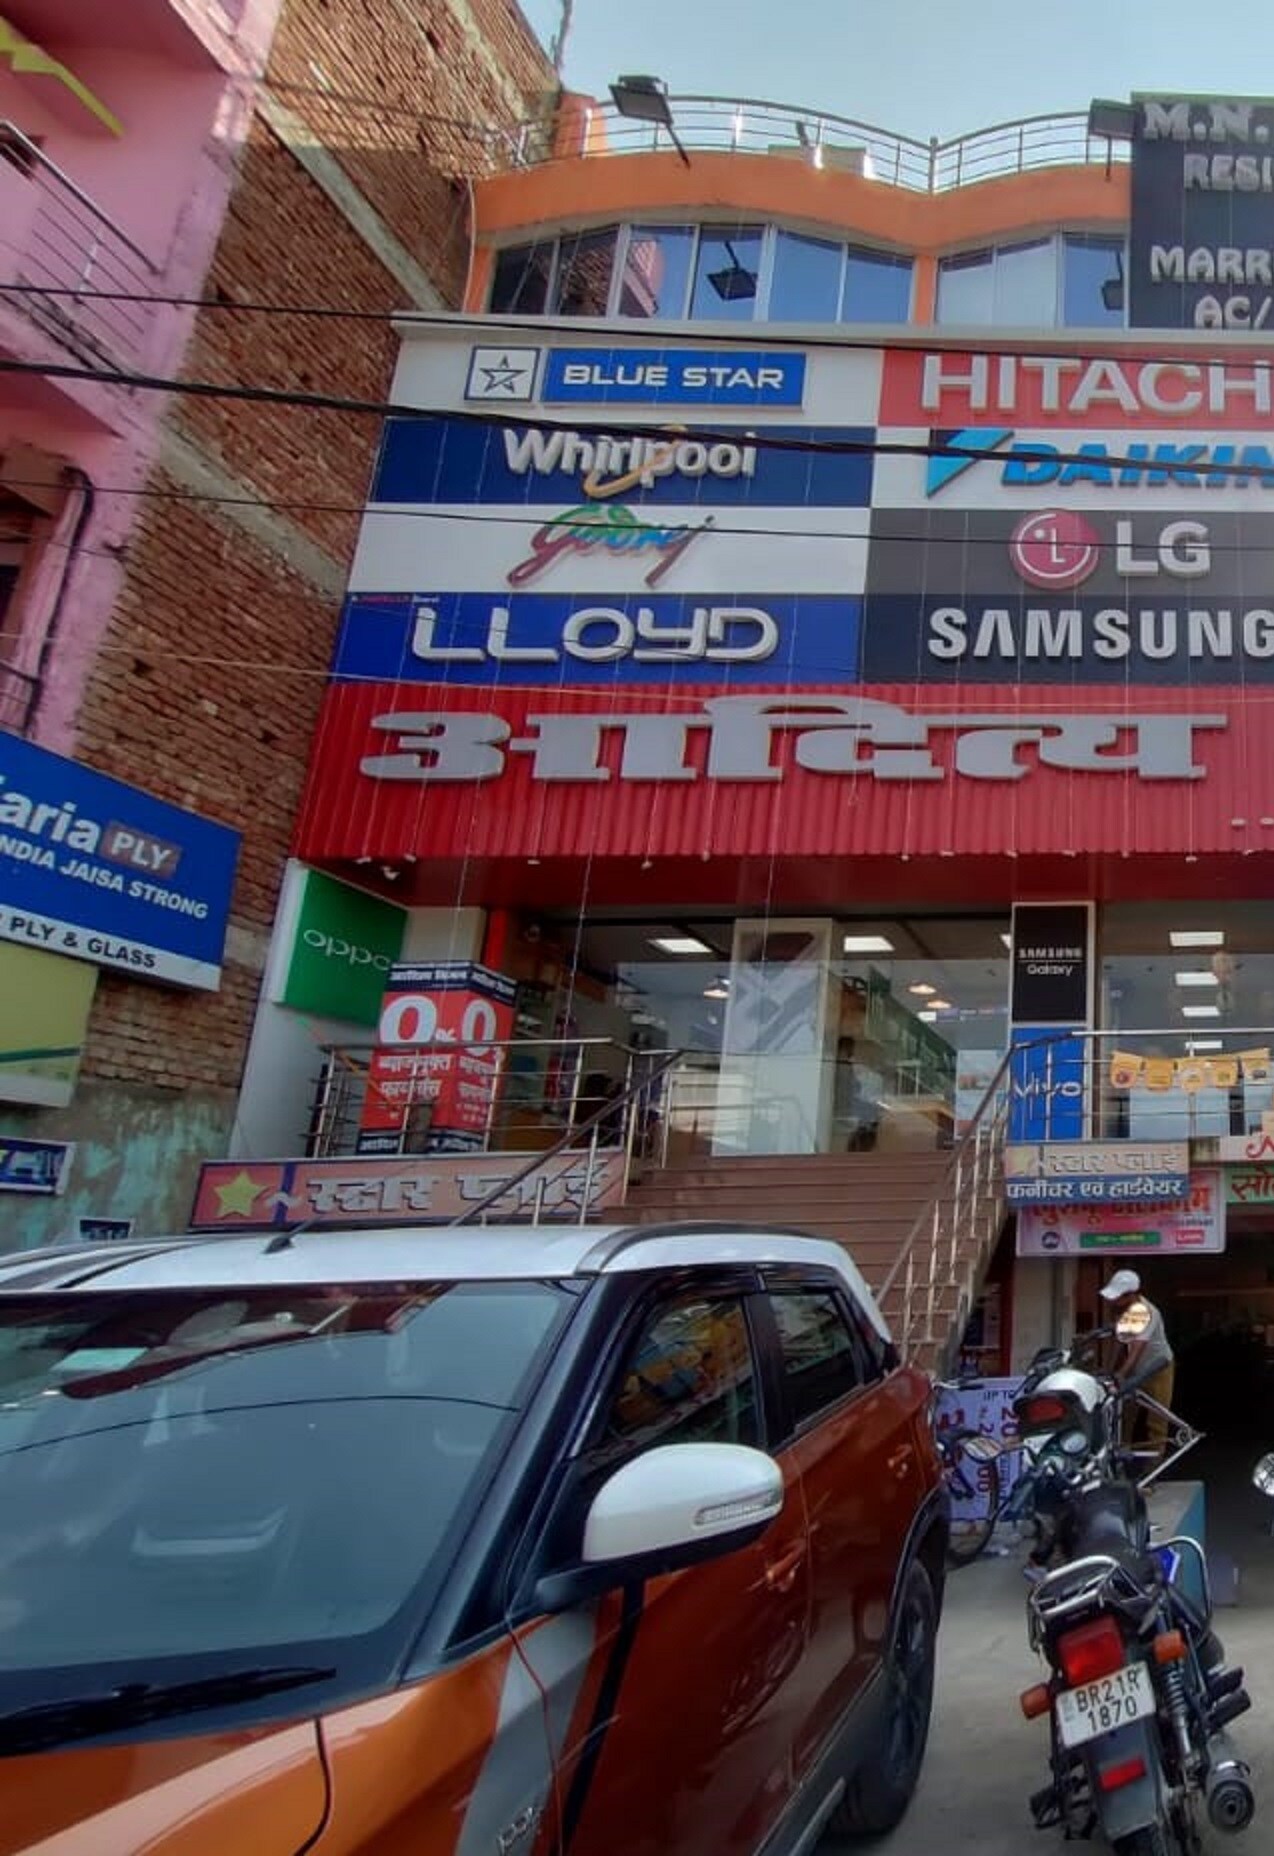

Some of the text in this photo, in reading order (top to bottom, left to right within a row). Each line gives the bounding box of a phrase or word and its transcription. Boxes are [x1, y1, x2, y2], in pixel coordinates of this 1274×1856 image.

[1142, 101, 1269, 142] M.N.
[563, 364, 785, 390] BLUE STAR
[502, 428, 757, 489] Whirlpool
[1115, 520, 1212, 578] LG
[411, 607, 779, 663] LLOYD
[360, 693, 1228, 782] आदित्य
[0, 776, 171, 871] aria PLY
[0, 834, 209, 919] NDIA JAISA STRONG
[10, 916, 157, 969] PLY & GLASS
[1018, 947, 1083, 959] SAMSUNG
[1027, 964, 1073, 977] Galaxy
[1080, 1178, 1104, 1197] एवं
[1088, 1696, 1137, 1732] 1870
